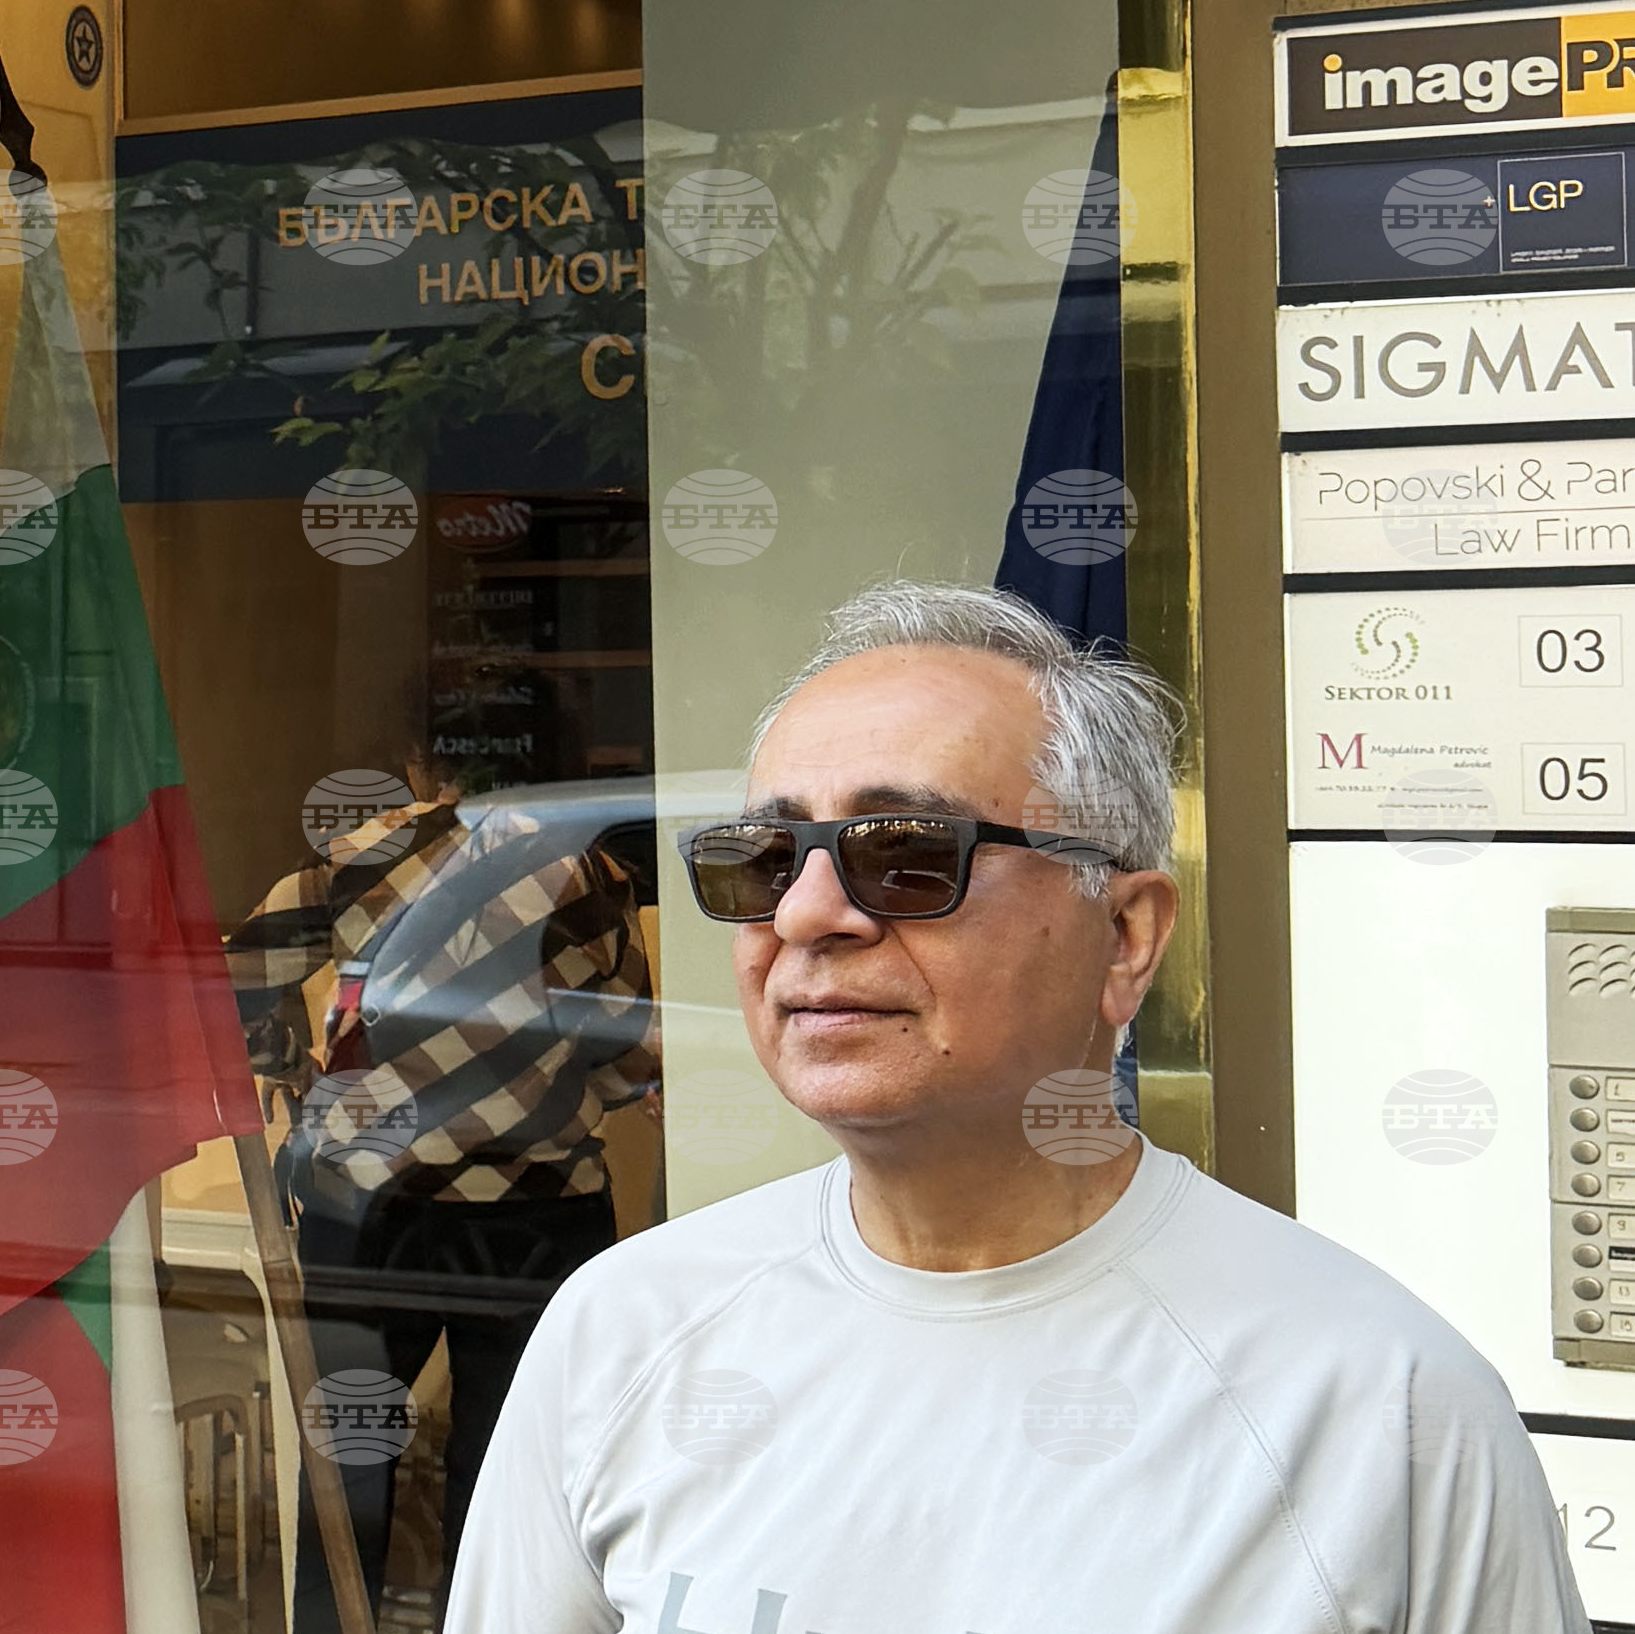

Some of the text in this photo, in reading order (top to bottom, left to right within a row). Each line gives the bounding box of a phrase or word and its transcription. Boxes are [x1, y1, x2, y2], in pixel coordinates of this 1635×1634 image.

[277, 182, 595, 249] БЪЛГАРСКА
[1508, 179, 1584, 213] LGP
[1318, 464, 1505, 512] Popovski
[1517, 458, 1556, 502] &
[1434, 517, 1631, 556] Law Firm
[1536, 628, 1606, 674] 03
[1415, 684, 1454, 702] 011
[1315, 731, 1369, 770] M
[1538, 755, 1609, 802] 05
